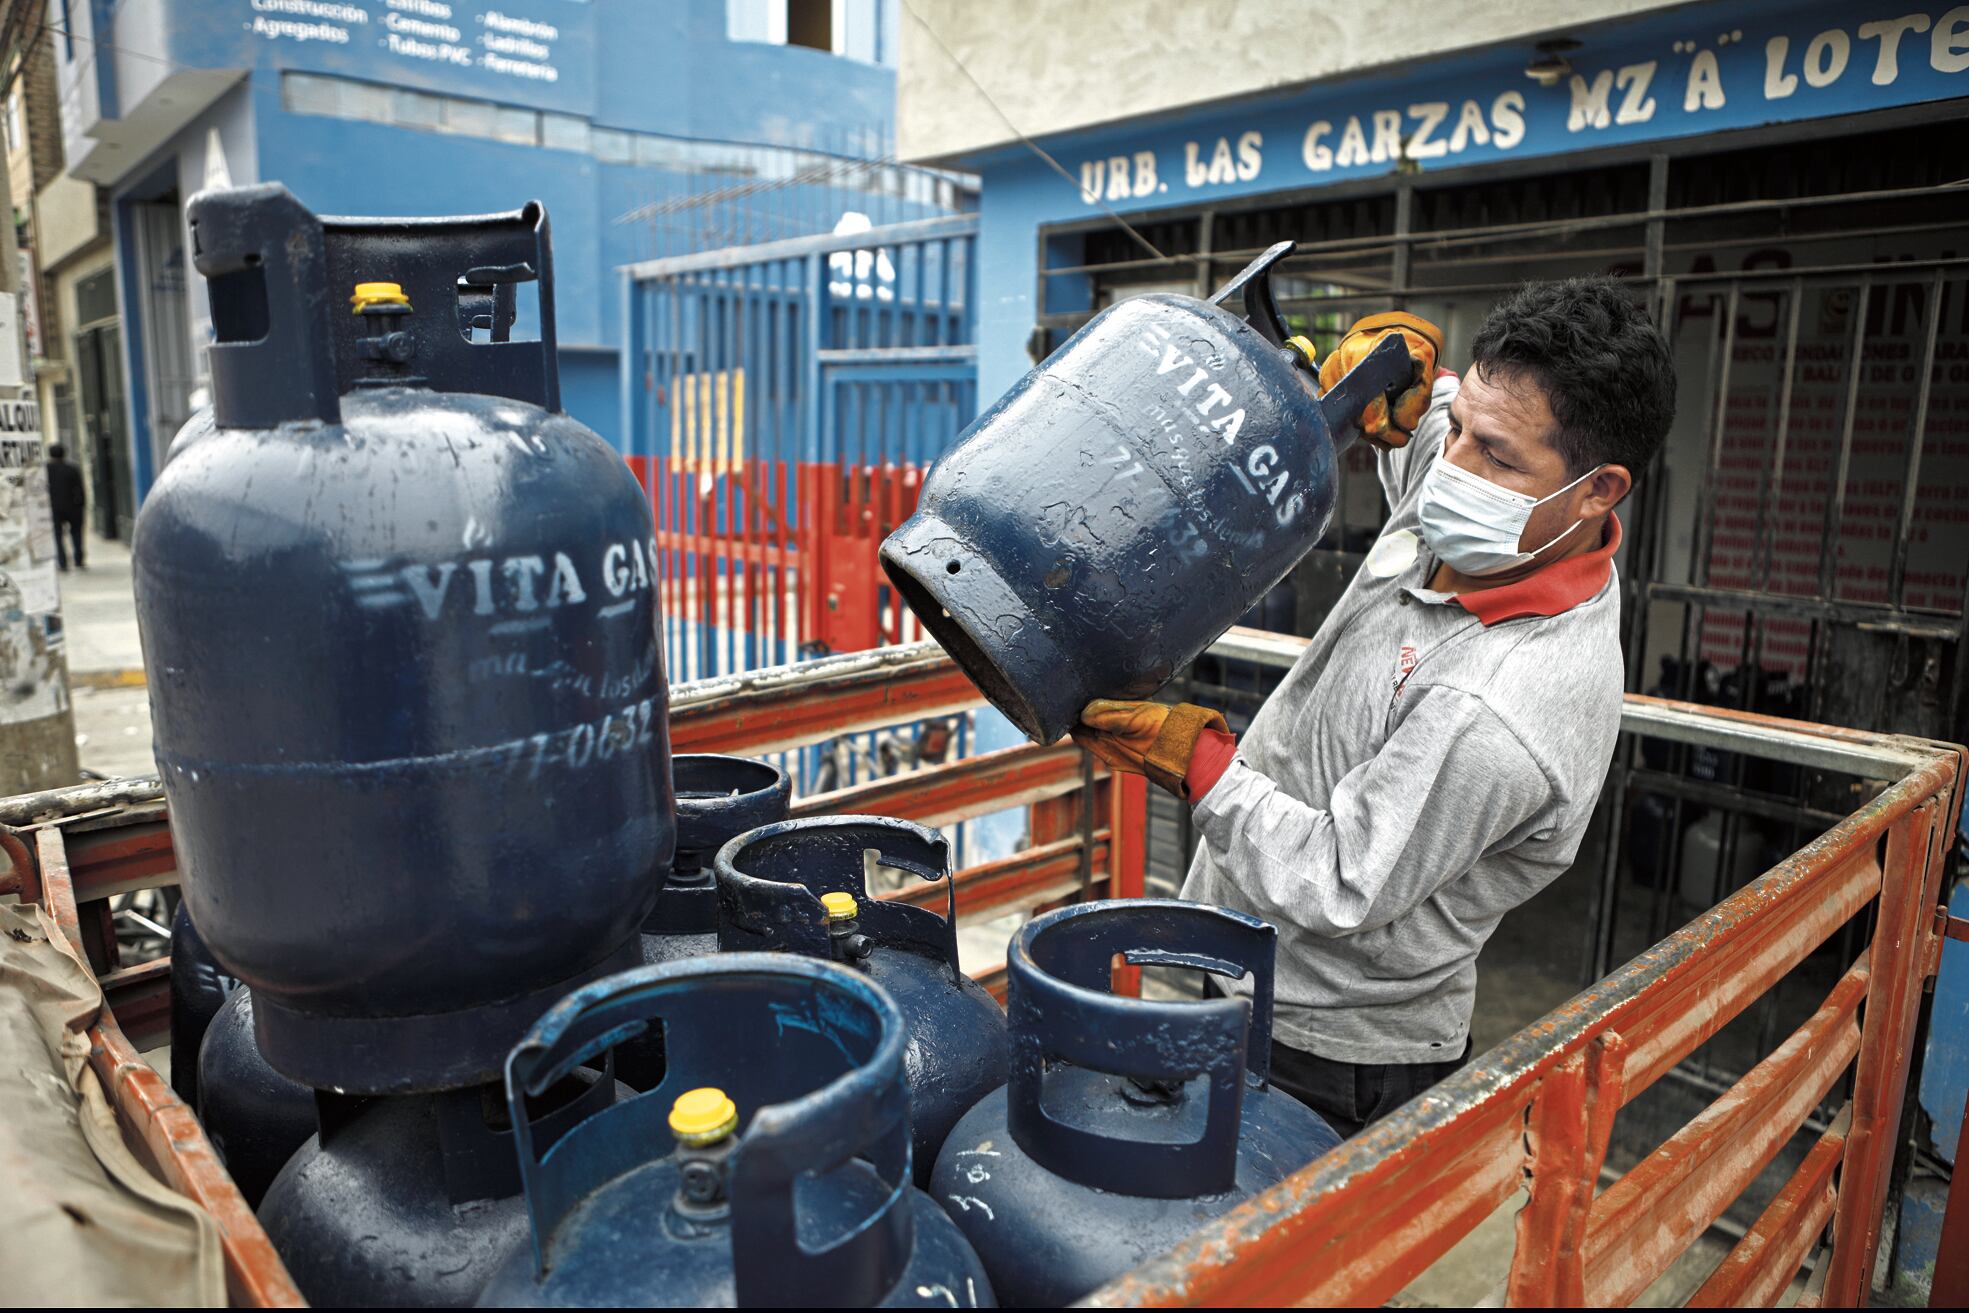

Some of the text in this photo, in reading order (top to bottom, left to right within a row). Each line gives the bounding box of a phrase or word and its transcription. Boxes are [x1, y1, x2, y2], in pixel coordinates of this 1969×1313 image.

[252, 17, 349, 43] Agregados
[385, 12, 461, 42] Cemento
[1081, 151, 1168, 205] URB.
[1185, 131, 1263, 188] LAS
[1303, 91, 1526, 171] GARZAS
[1567, 61, 1657, 132] MZ
[1156, 344, 1246, 445] VITA
[1249, 445, 1304, 528] GAS
[402, 552, 587, 620] VITA
